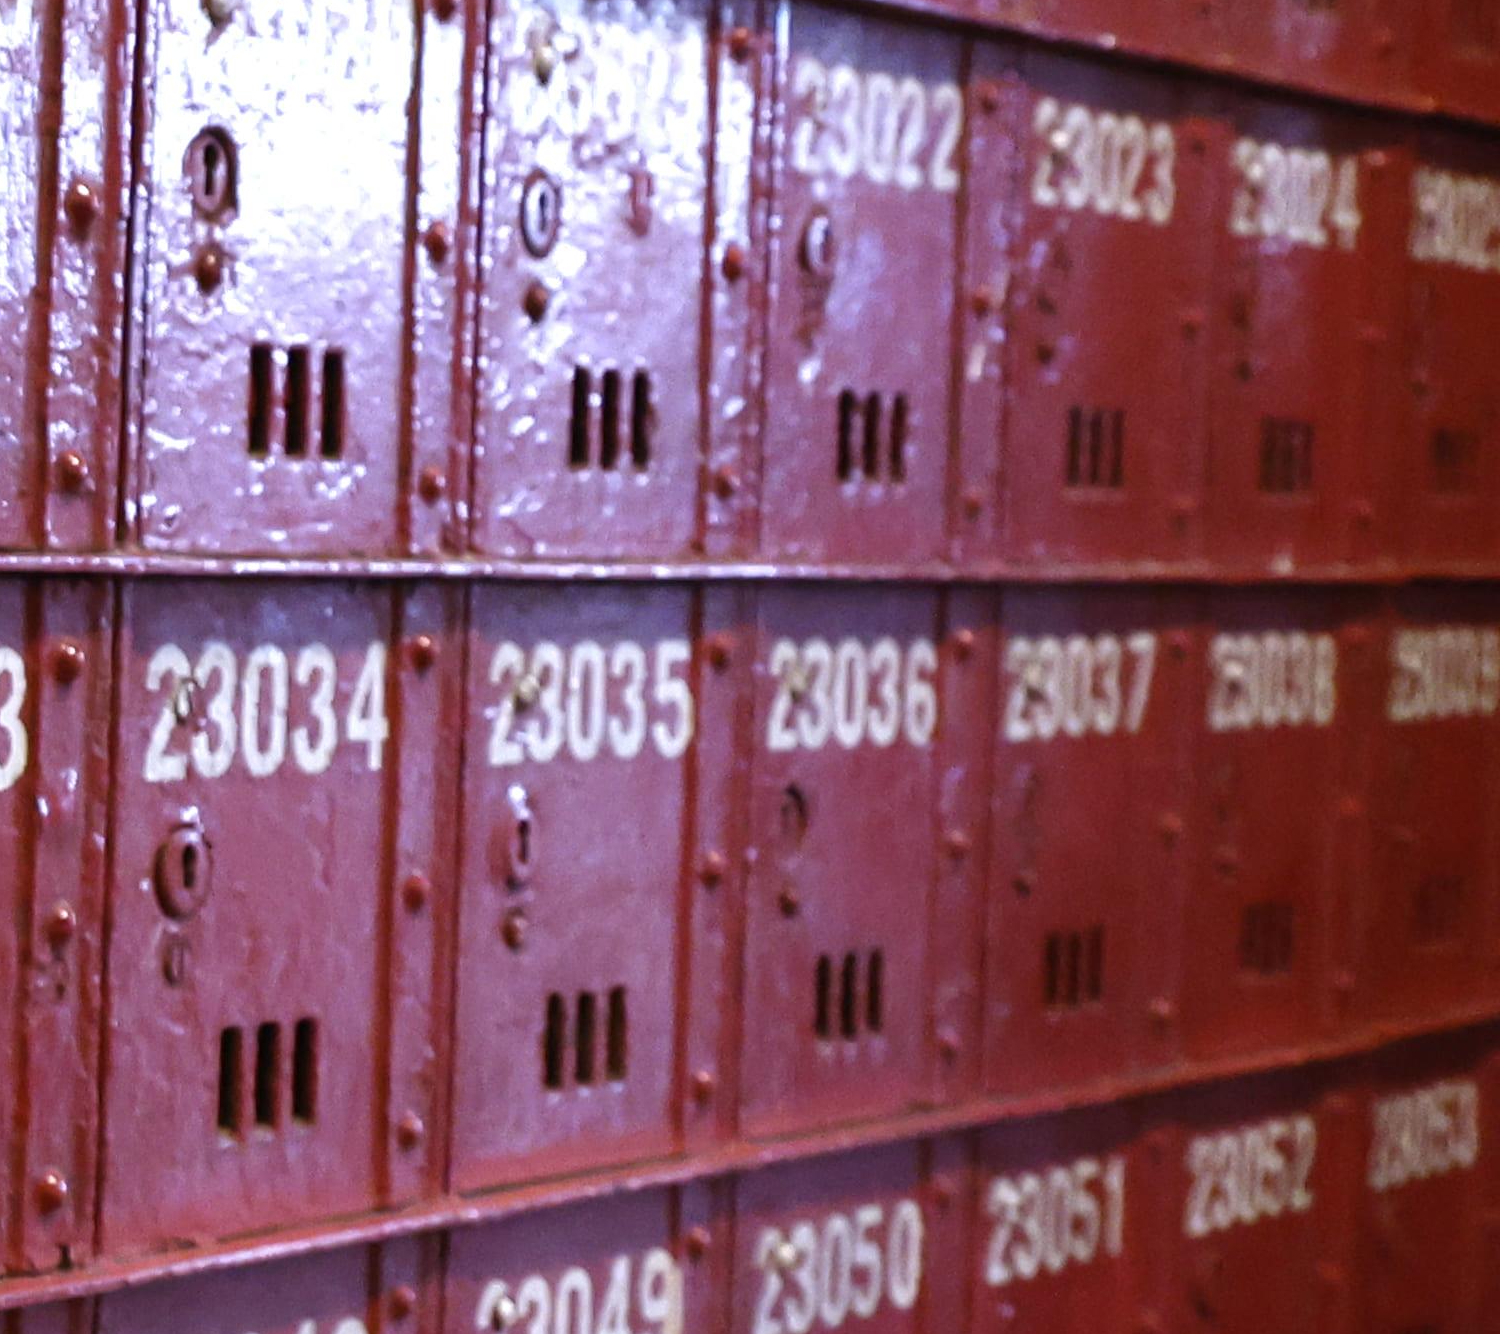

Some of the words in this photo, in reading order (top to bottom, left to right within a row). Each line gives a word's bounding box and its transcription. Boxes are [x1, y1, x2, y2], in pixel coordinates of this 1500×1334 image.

[793, 59, 957, 189] 23022
[1033, 99, 1172, 222] 23023
[144, 644, 387, 781] 23034
[485, 641, 690, 765] 23035
[768, 641, 934, 749] 23036
[1005, 634, 1154, 741] 23037
[985, 1161, 1123, 1285] 23051
